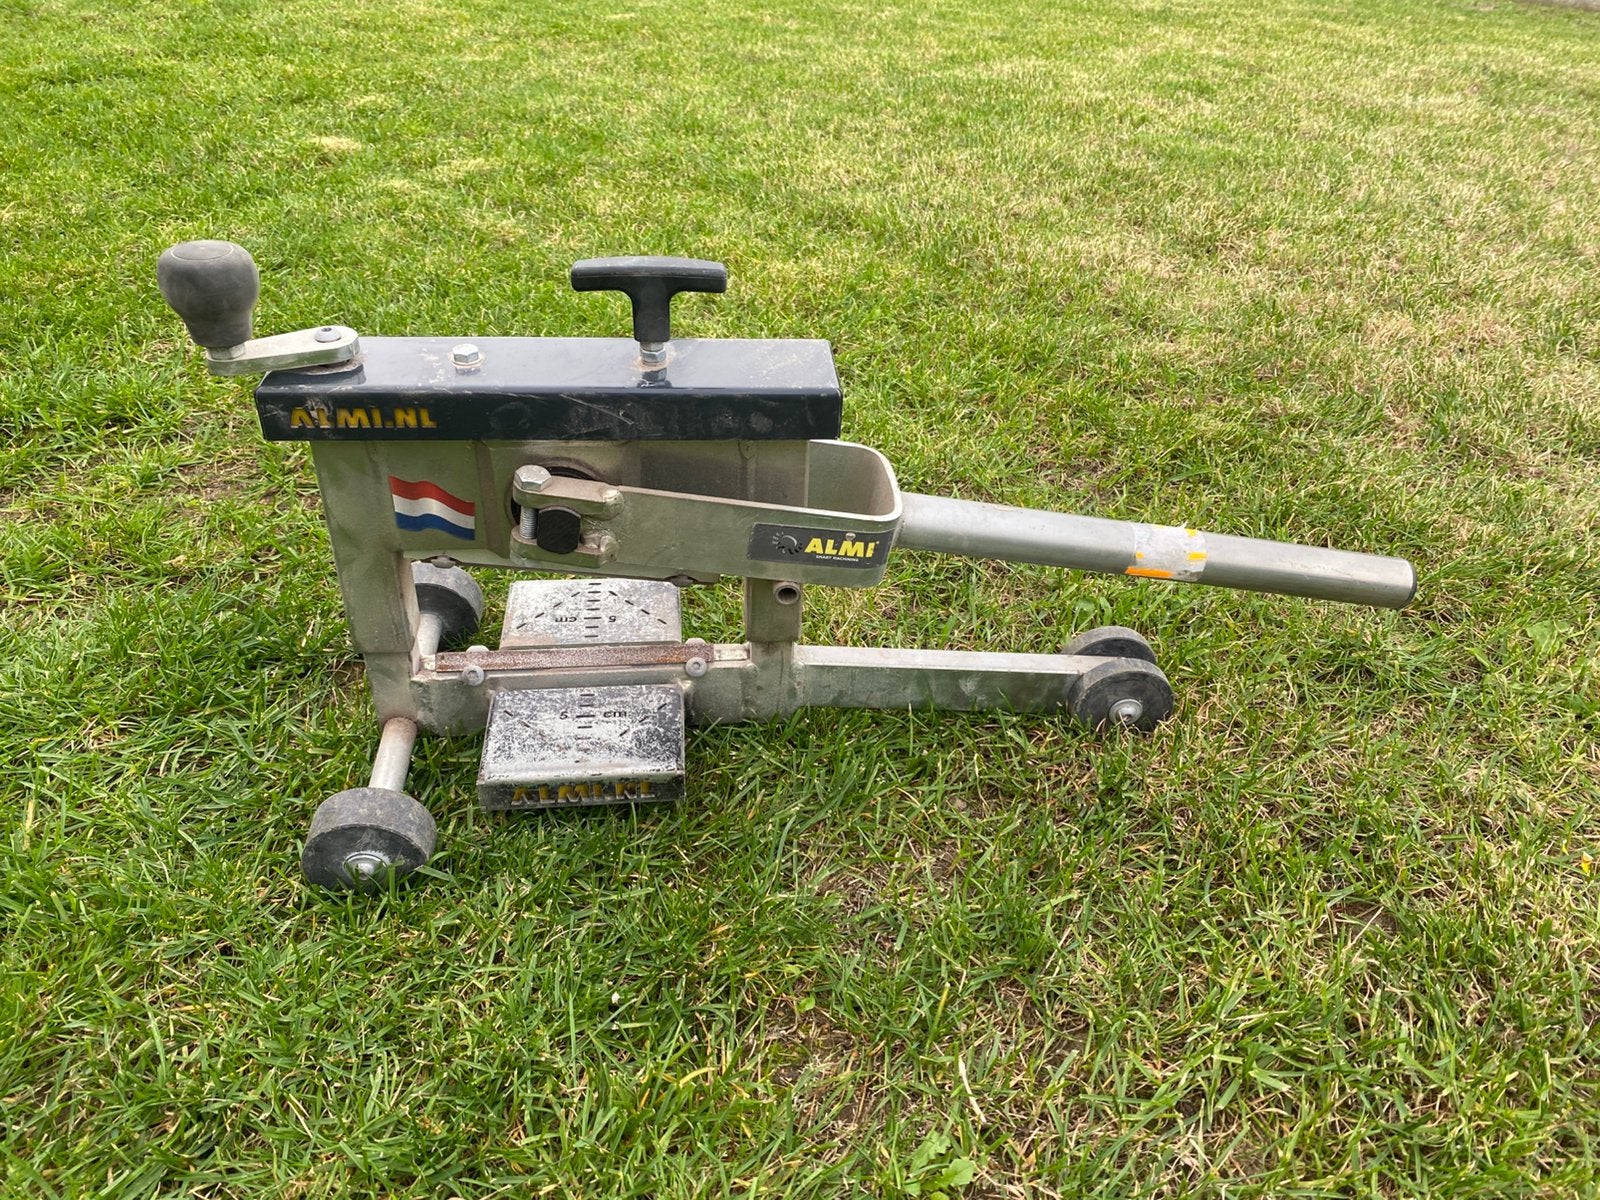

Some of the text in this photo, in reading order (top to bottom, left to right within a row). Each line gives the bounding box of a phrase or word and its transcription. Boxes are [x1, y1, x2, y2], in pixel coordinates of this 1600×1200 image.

[290, 406, 438, 429] ALMI.NL
[804, 536, 876, 558] ALMI
[608, 615, 617, 623] 5
[559, 711, 628, 720] 5 cm
[511, 780, 656, 806] ALMI.NL
